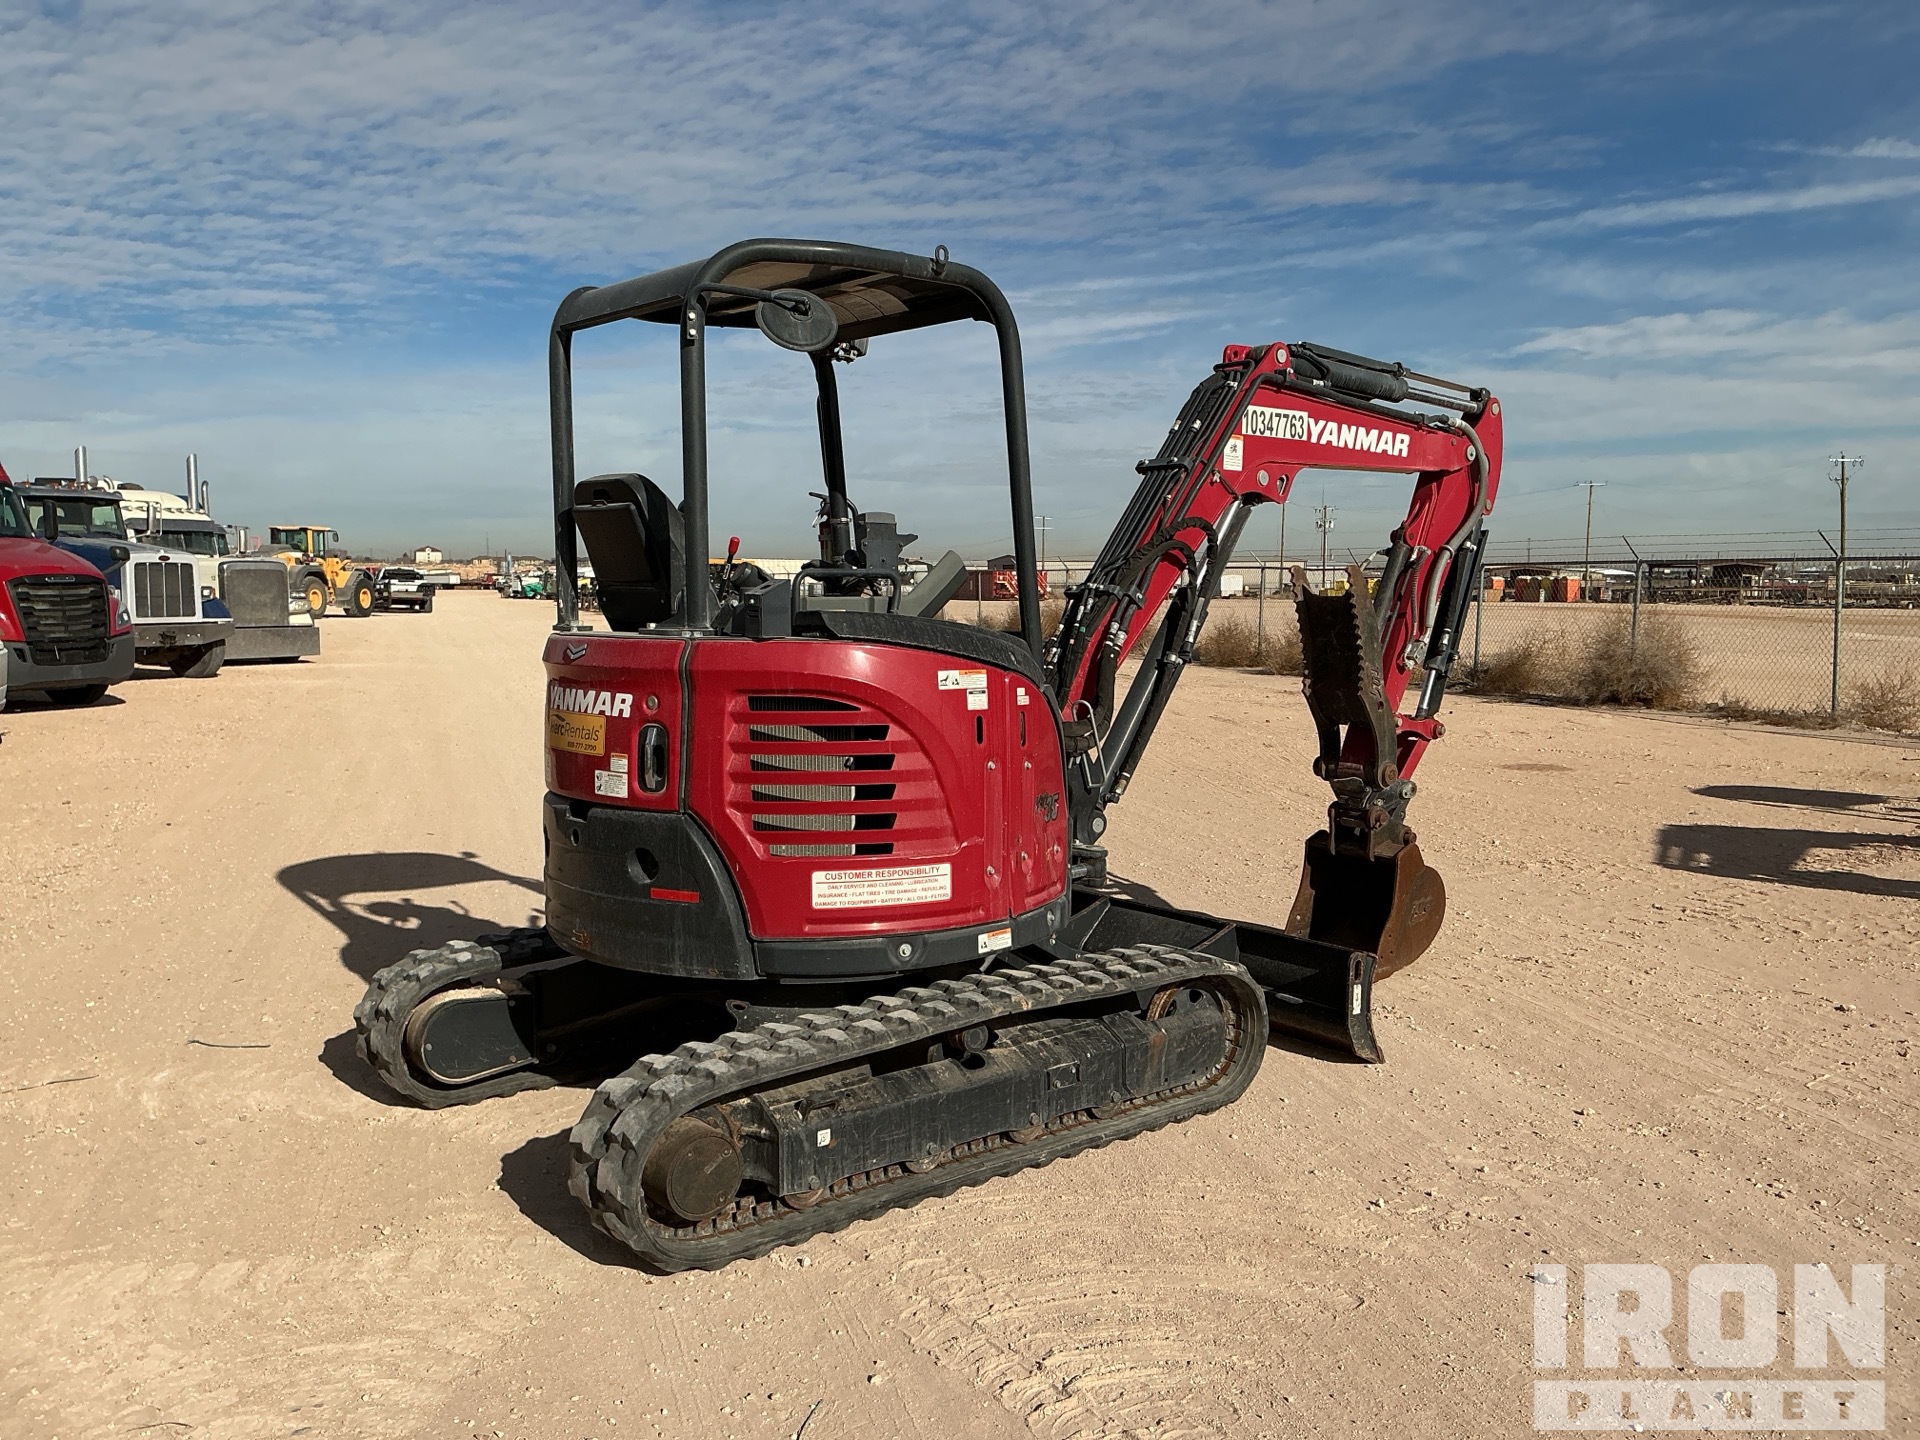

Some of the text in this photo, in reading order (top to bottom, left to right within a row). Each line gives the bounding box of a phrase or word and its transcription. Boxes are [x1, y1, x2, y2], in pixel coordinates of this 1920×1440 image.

[1243, 410, 1305, 439] 10347763
[1308, 417, 1411, 458] YANMAR
[550, 685, 634, 718] YANMAR
[824, 866, 941, 880] CUSTOMER RESPONSIBILITY
[878, 880, 904, 888] CLEANING
[907, 878, 939, 886] LUBRICATION
